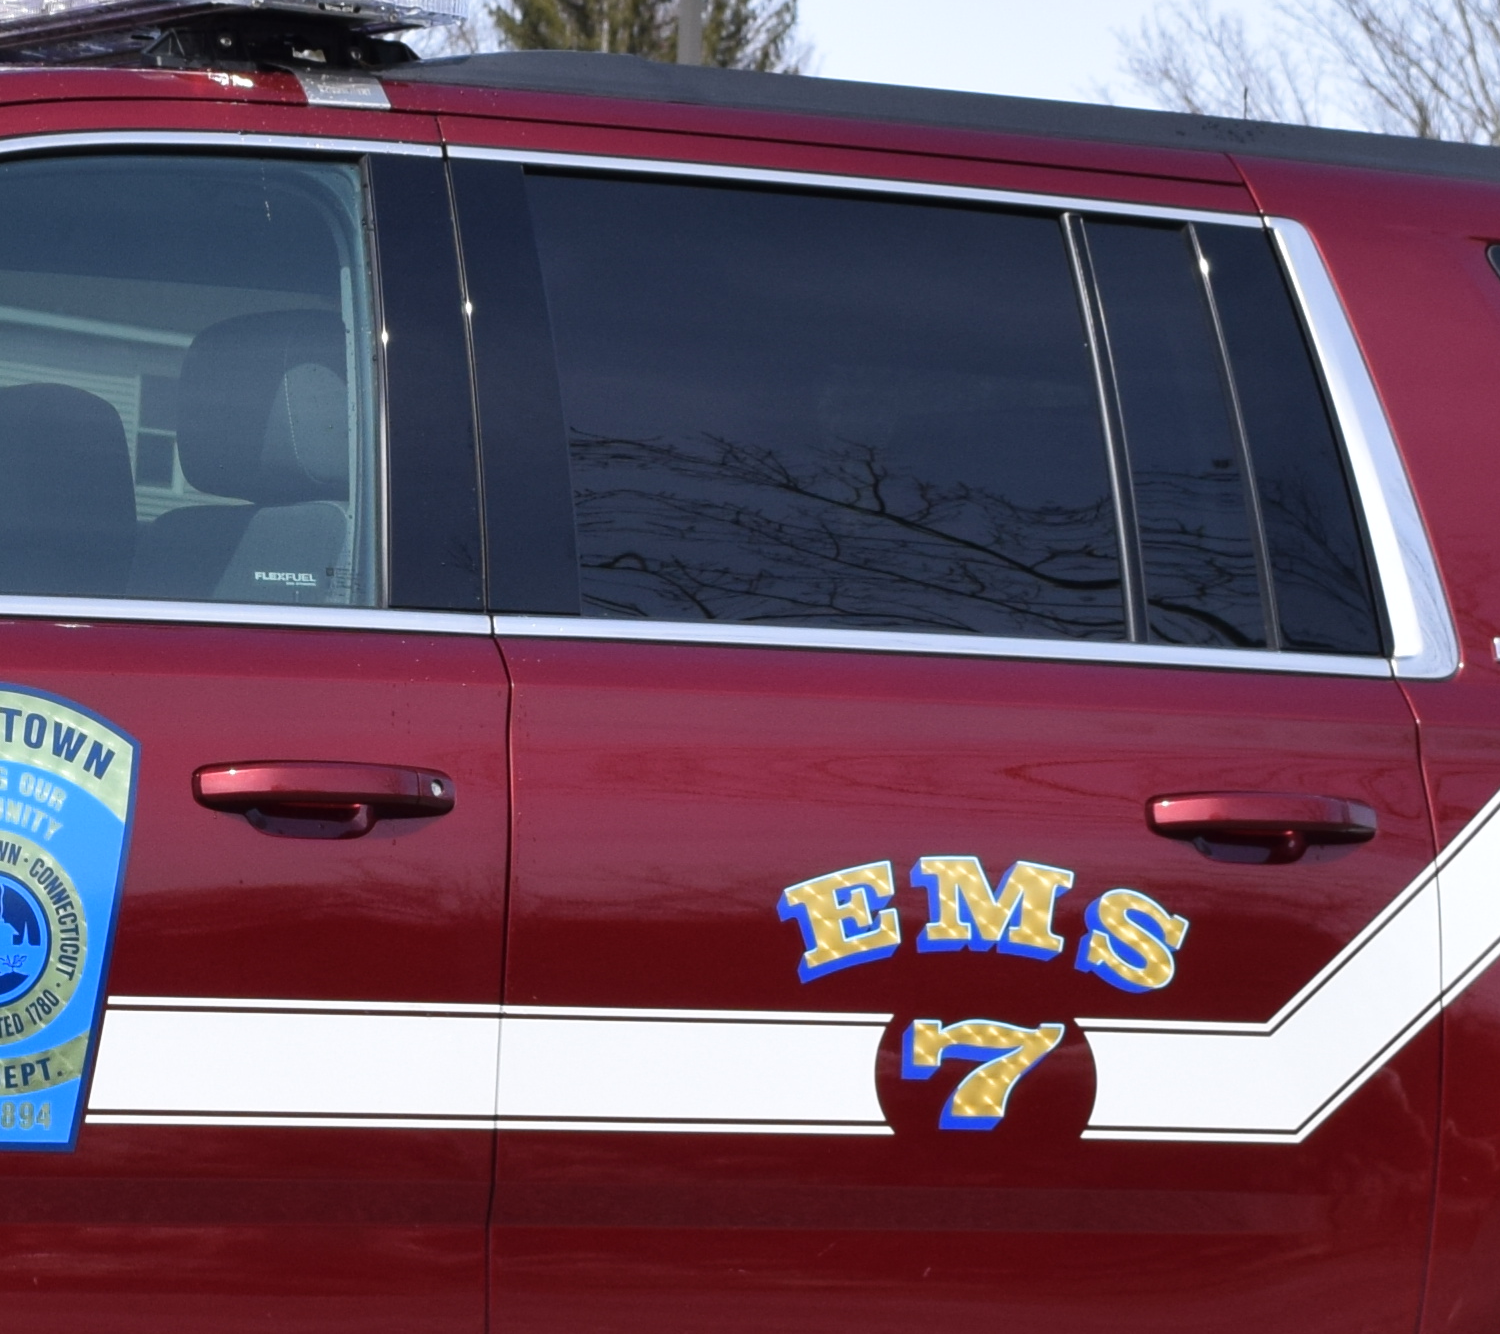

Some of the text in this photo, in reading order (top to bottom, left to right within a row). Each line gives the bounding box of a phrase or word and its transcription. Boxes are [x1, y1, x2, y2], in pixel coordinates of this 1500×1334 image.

[254, 571, 317, 583] FLEXFUEL
[18, 771, 67, 813] OUR
[28, 857, 81, 982] CONNECTICUT
[776, 855, 1190, 994] EMS
[24, 988, 61, 1026] 1780
[901, 1018, 1066, 1131] 7
